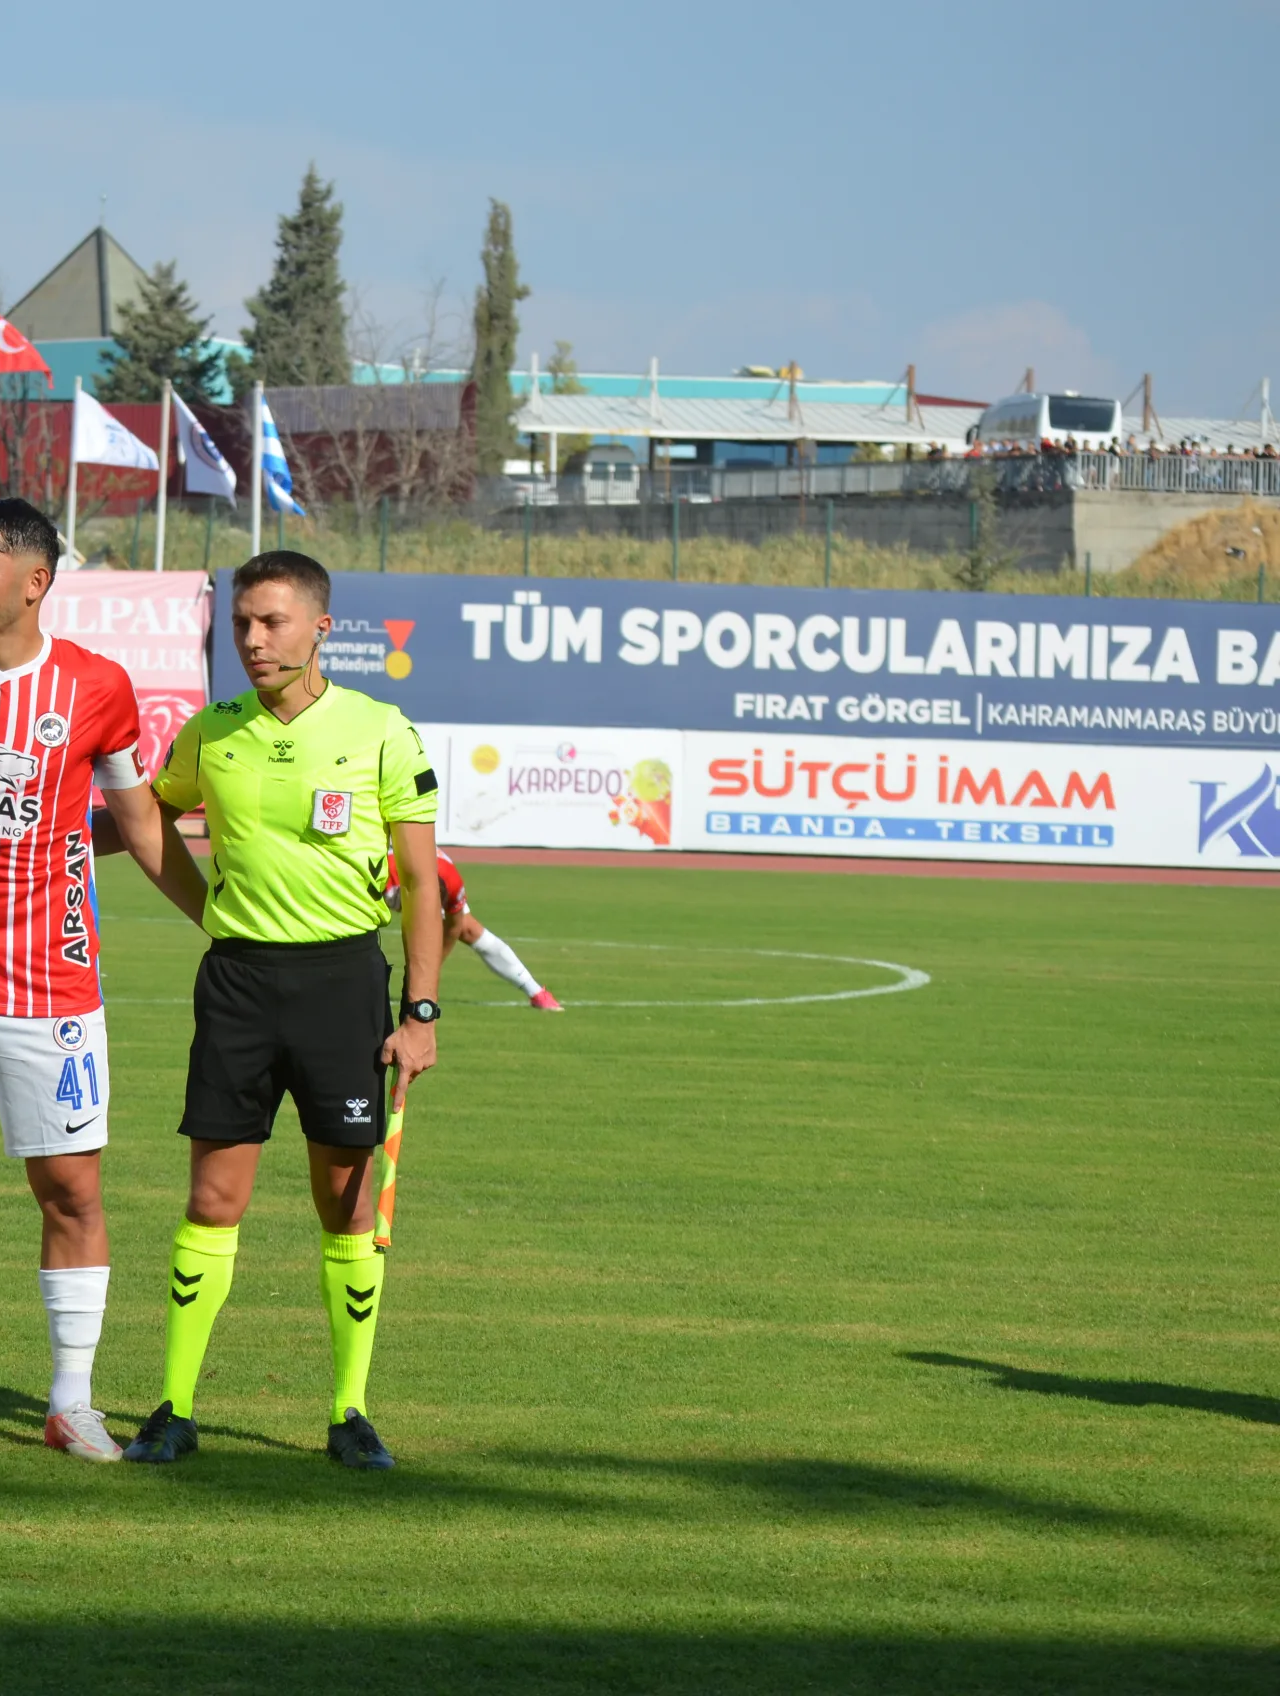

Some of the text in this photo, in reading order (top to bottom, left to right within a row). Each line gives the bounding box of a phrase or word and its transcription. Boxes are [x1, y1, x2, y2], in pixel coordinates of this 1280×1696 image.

[461, 590, 602, 663] TÜM
[619, 607, 1200, 684] SPORCULARIMIZA
[734, 693, 829, 721] FIRAT
[836, 693, 971, 726] GÖRGEL
[987, 703, 1206, 736] KAHRAMANMARAŞ
[268, 755, 295, 763] hummel
[508, 766, 622, 797] KARPEDO
[708, 748, 1117, 811] SÜTÇÜ İMAM
[320, 820, 343, 831] TFF
[711, 813, 886, 838] BRANDA
[63, 831, 89, 966] ARSAN
[55, 1051, 100, 1111] 41
[344, 1115, 372, 1123] hummel
